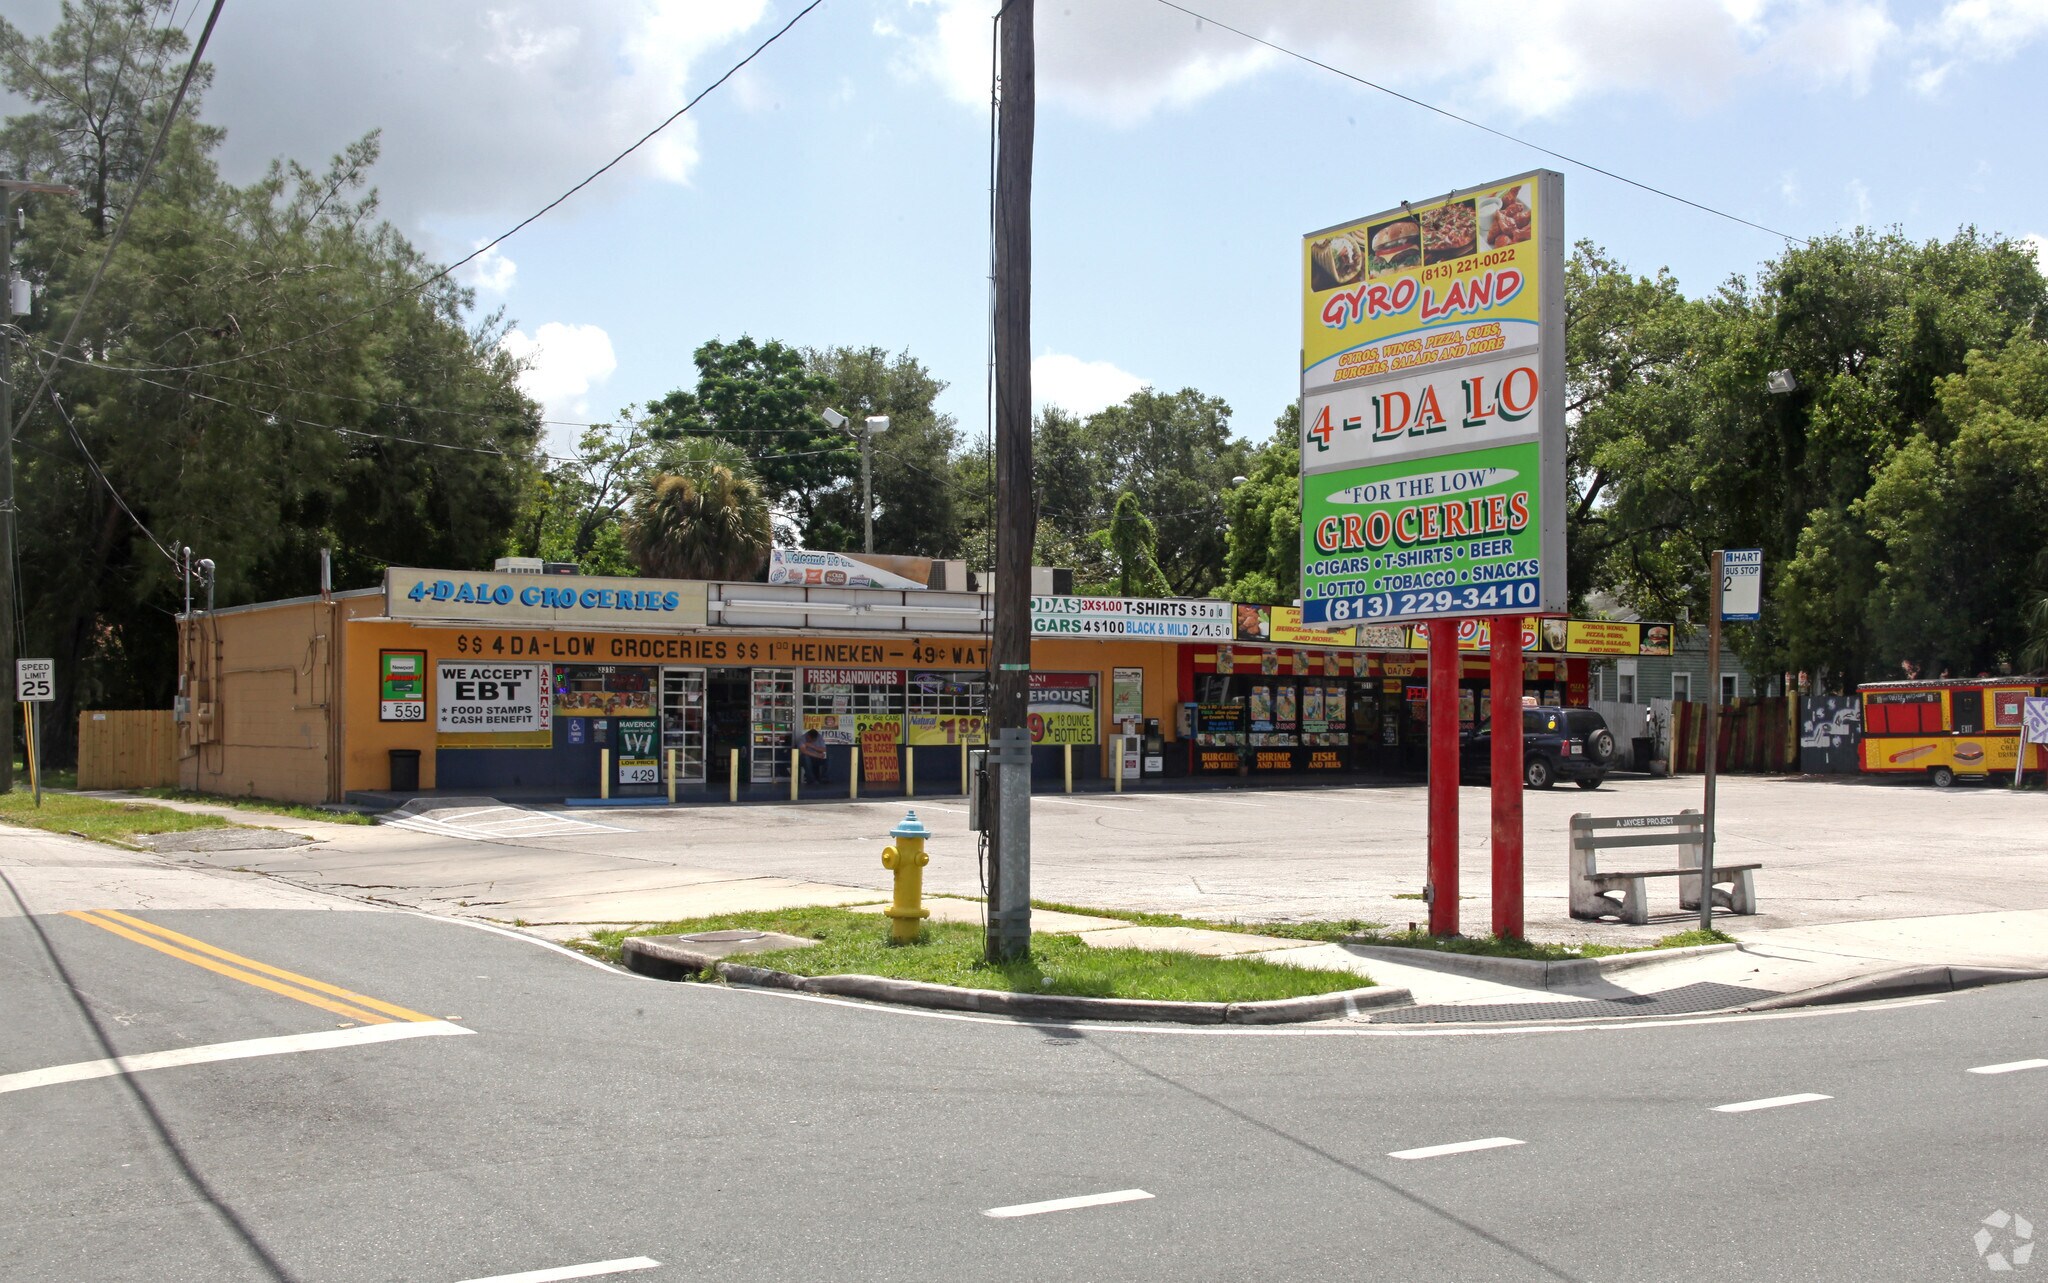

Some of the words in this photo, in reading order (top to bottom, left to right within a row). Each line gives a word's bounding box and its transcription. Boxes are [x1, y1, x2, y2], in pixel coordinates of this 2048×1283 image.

[1421, 264, 1453, 284] (813)
[1456, 249, 1516, 275] 221-0022
[1321, 276, 1418, 328] GYRO
[1420, 268, 1523, 322] LAND
[1338, 348, 1379, 367] GYROS,
[1382, 339, 1422, 358] WINGS,
[1425, 330, 1463, 349] PIZZA,
[1466, 322, 1502, 340] SUBS,
[1334, 361, 1389, 382] BURGERS,
[1391, 351, 1438, 370] SALADS
[1439, 344, 1467, 361] AND
[1467, 336, 1505, 357] MORE
[1396, 477, 1434, 499] THE
[1316, 491, 1530, 553] GROCERIES
[785, 551, 826, 564] Welcome
[1313, 556, 1370, 576] CIGARS
[1383, 545, 1454, 568] T-SHIRTS
[1470, 538, 1513, 559] BEER
[1733, 552, 1760, 563] HART
[1318, 578, 1366, 598] LOTTO
[1382, 569, 1457, 591] TOBACCO
[1472, 559, 1540, 581] SNACKS
[1725, 567, 1739, 576] BUS
[1740, 566, 1760, 575] STOP
[1723, 576, 1732, 592] 2
[408, 579, 515, 606] 4-DALO
[519, 586, 681, 612] GROCERIES
[1324, 592, 1394, 622] (813)
[1399, 581, 1537, 616] 229-3410
[1124, 601, 1187, 617] T-SHIRTS
[1031, 618, 1082, 633] GARS
[1126, 621, 1156, 635] BLACK
[1158, 623, 1165, 635] &
[1167, 623, 1188, 636] MILD
[611, 638, 727, 660] GROCERIES
[791, 644, 884, 663] HEINEKEN
[21, 663, 50, 672] SPEED
[442, 669, 467, 680] WE
[470, 669, 533, 680] ACCEPT
[24, 672, 46, 680] LIMIT
[807, 669, 838, 684] FRESH
[839, 670, 898, 685] SANDWICHES
[22, 681, 51, 697] 25
[455, 681, 522, 701] EBT
[451, 706, 483, 715] FOOD
[486, 706, 532, 715] STAMPS
[451, 715, 483, 724] CASH
[486, 715, 533, 724] BENEFIT
[910, 715, 938, 725] Natural
[1057, 715, 1065, 727] 18
[1066, 715, 1090, 727] OUNCE
[1054, 728, 1093, 743] BOTTLES
[1961, 724, 1973, 734] EXIT
[864, 734, 892, 742] NOW
[874, 743, 897, 754] ACCEPT
[864, 756, 878, 770] EBT
[879, 756, 898, 770] FOOD
[1257, 752, 1292, 761] SHRIMP
[1312, 752, 1337, 761] FISH
[866, 772, 884, 780] STAMP
[885, 772, 899, 780] CARD
[1616, 818, 1622, 827] A
[1622, 818, 1646, 827] JAYCEE
[1646, 817, 1674, 825] PROJECT
